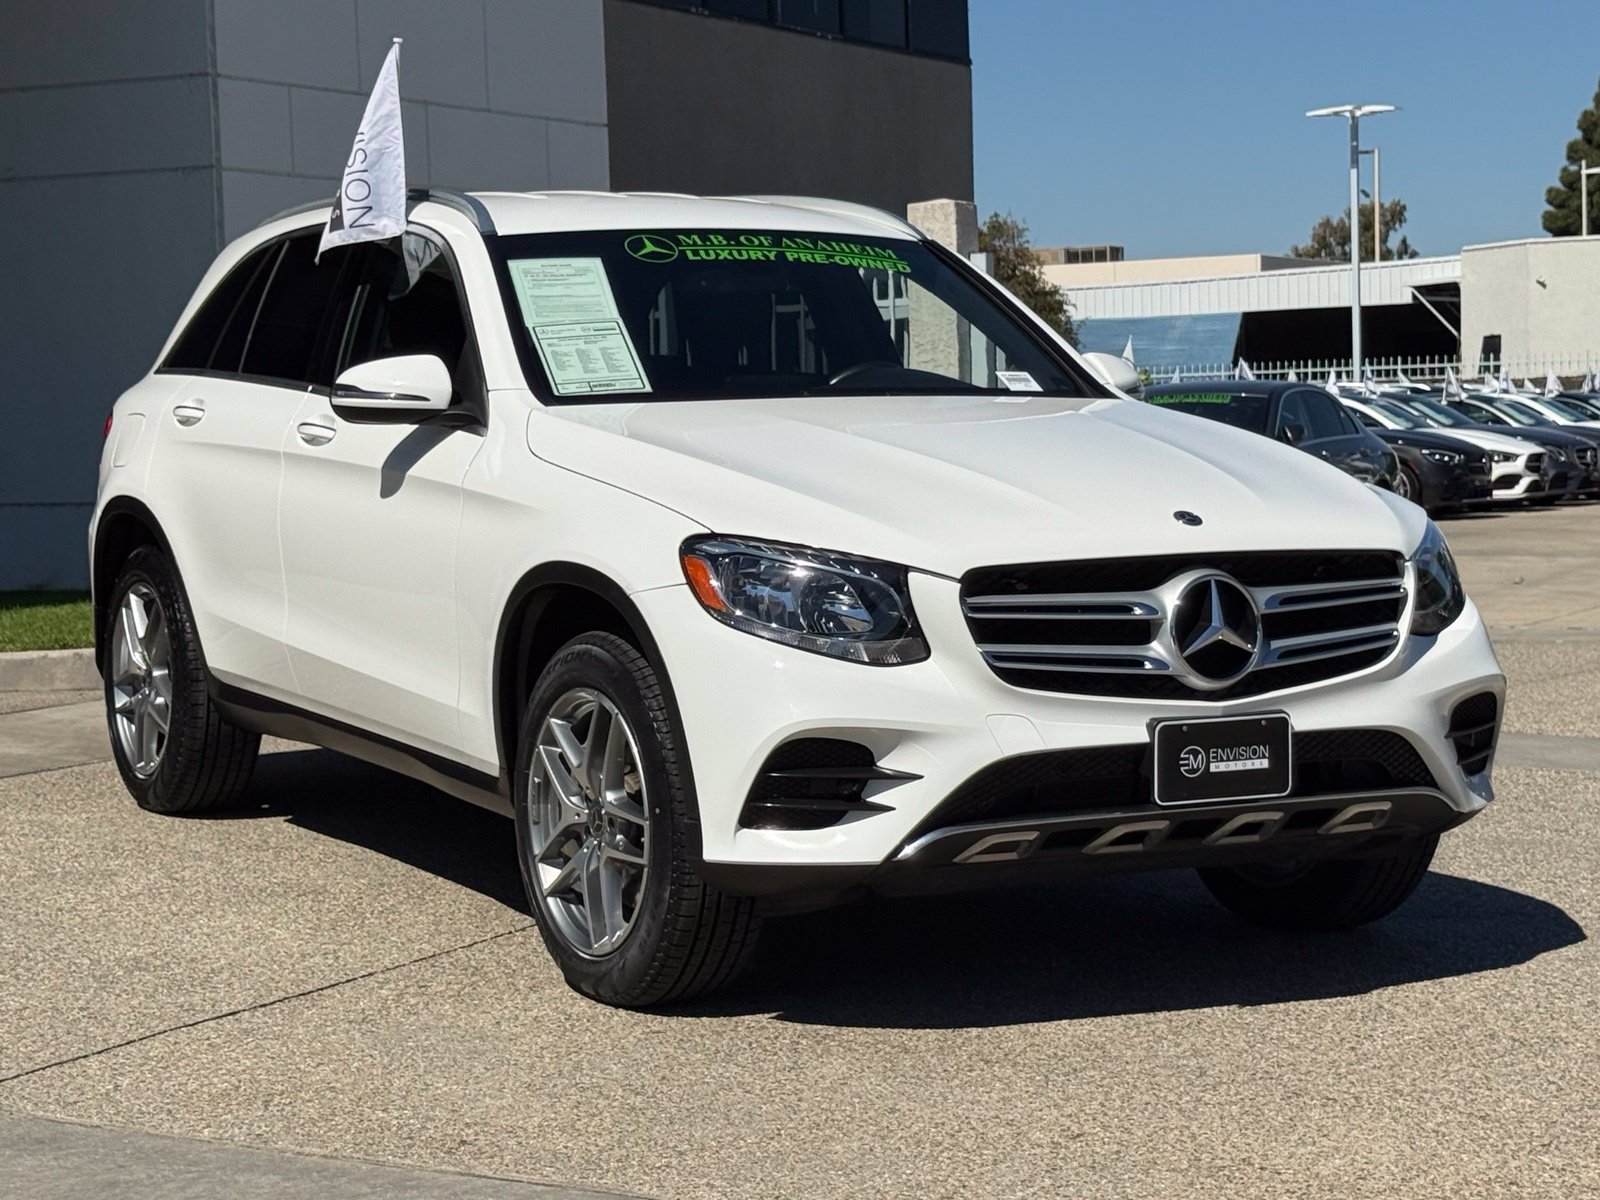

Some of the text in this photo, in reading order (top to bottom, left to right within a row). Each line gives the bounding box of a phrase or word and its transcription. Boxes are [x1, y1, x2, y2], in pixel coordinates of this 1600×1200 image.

[677, 234, 898, 259] M.B. OF ANAHEIM
[685, 250, 912, 273] LUXURY PRE-OWNED
[1209, 745, 1269, 762] ENVISION
[1214, 761, 1264, 770] MOTORS
